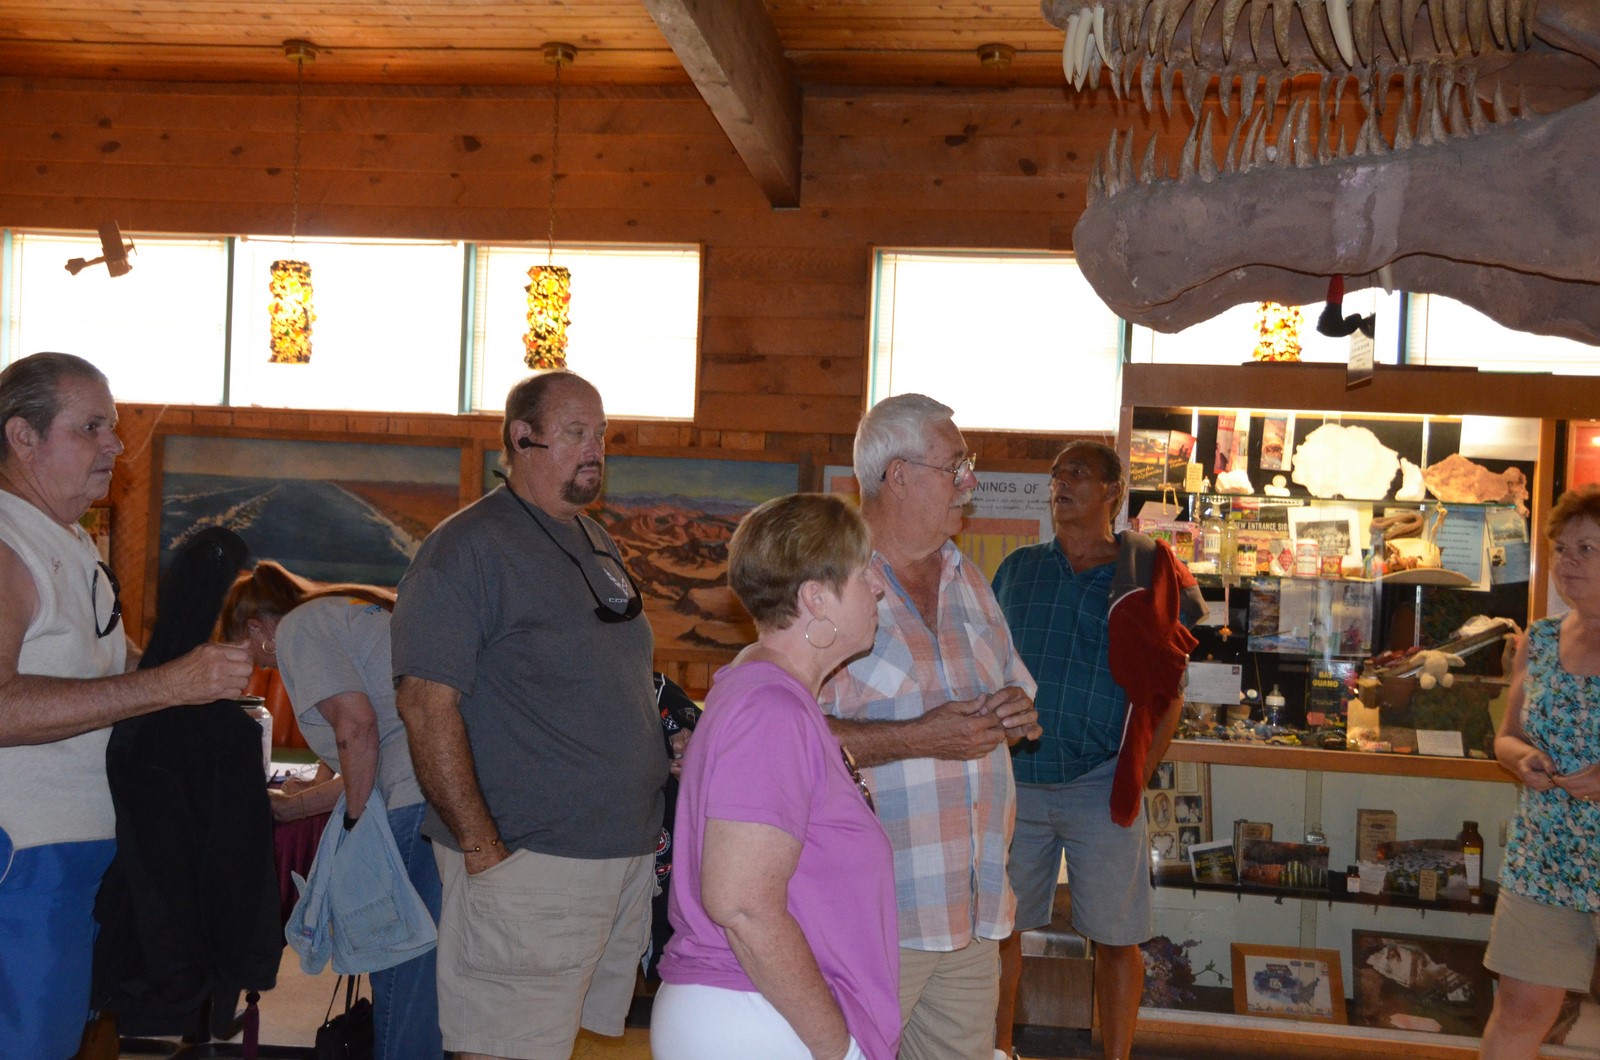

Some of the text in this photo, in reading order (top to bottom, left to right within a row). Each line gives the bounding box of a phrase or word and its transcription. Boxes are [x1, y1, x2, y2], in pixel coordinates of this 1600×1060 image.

[974, 481, 1039, 494] NINGS OF
[1248, 522, 1276, 531] ENTRANCE
[1312, 679, 1338, 687] GUANO
